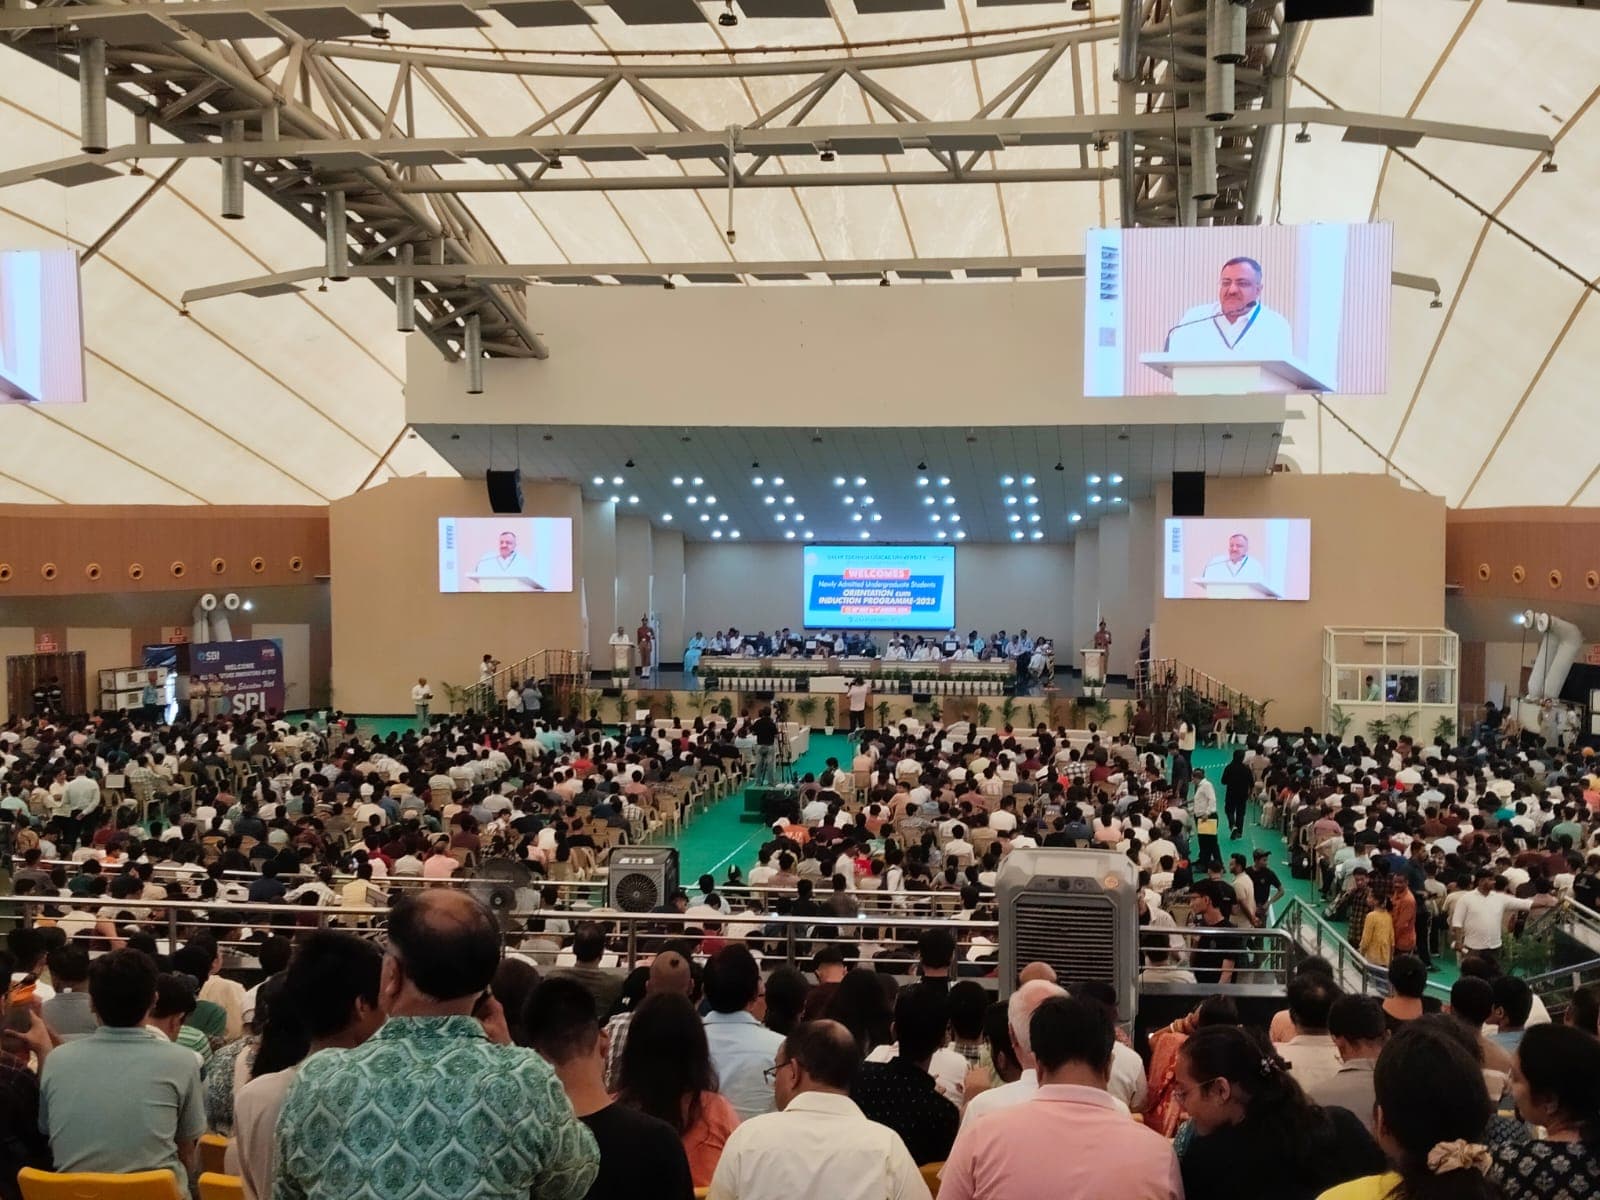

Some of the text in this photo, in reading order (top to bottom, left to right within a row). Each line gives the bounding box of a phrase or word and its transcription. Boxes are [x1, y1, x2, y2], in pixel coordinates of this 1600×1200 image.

[818, 580, 836, 588] Newly
[838, 580, 864, 588] Admitted
[865, 580, 909, 589] Undergraduate
[843, 589, 893, 597] ORIENTATION
[206, 650, 220, 661] SBI
